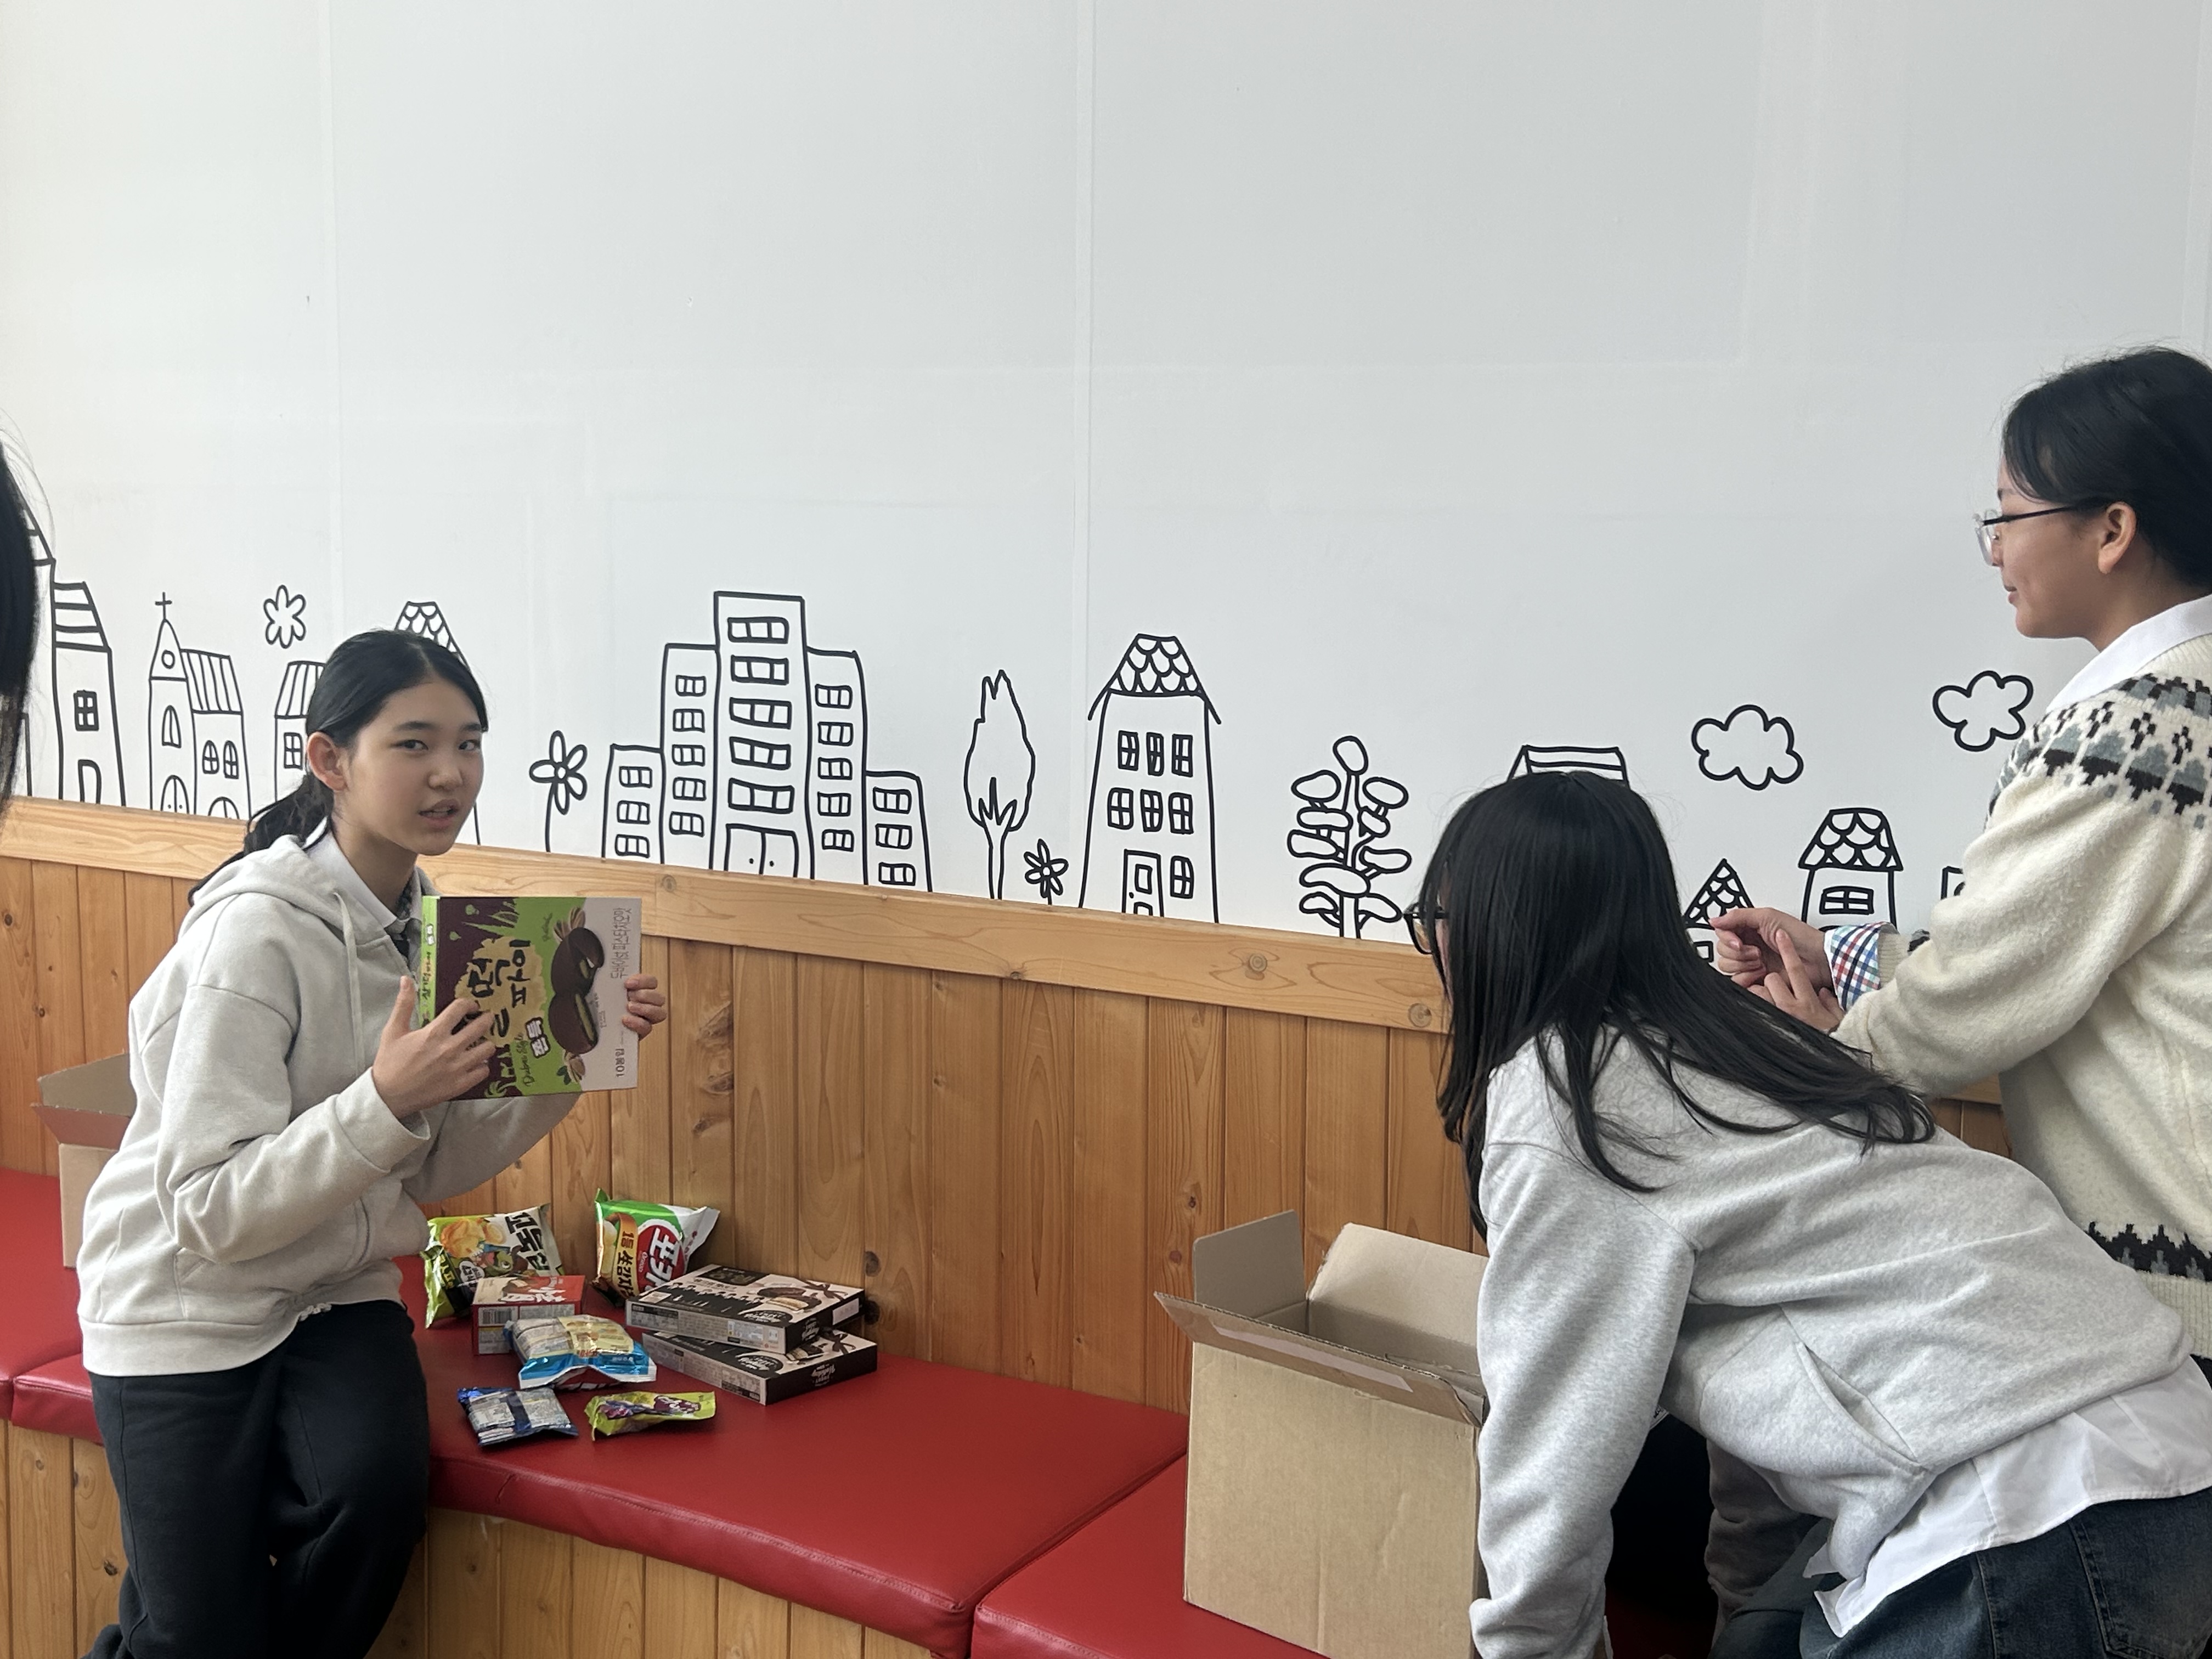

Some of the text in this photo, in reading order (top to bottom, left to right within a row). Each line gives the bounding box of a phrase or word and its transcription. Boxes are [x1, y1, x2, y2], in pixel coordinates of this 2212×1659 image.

[506, 940, 531, 1008] 파이
[620, 1231, 635, 1250] 1등
[644, 1227, 679, 1291] 포카
